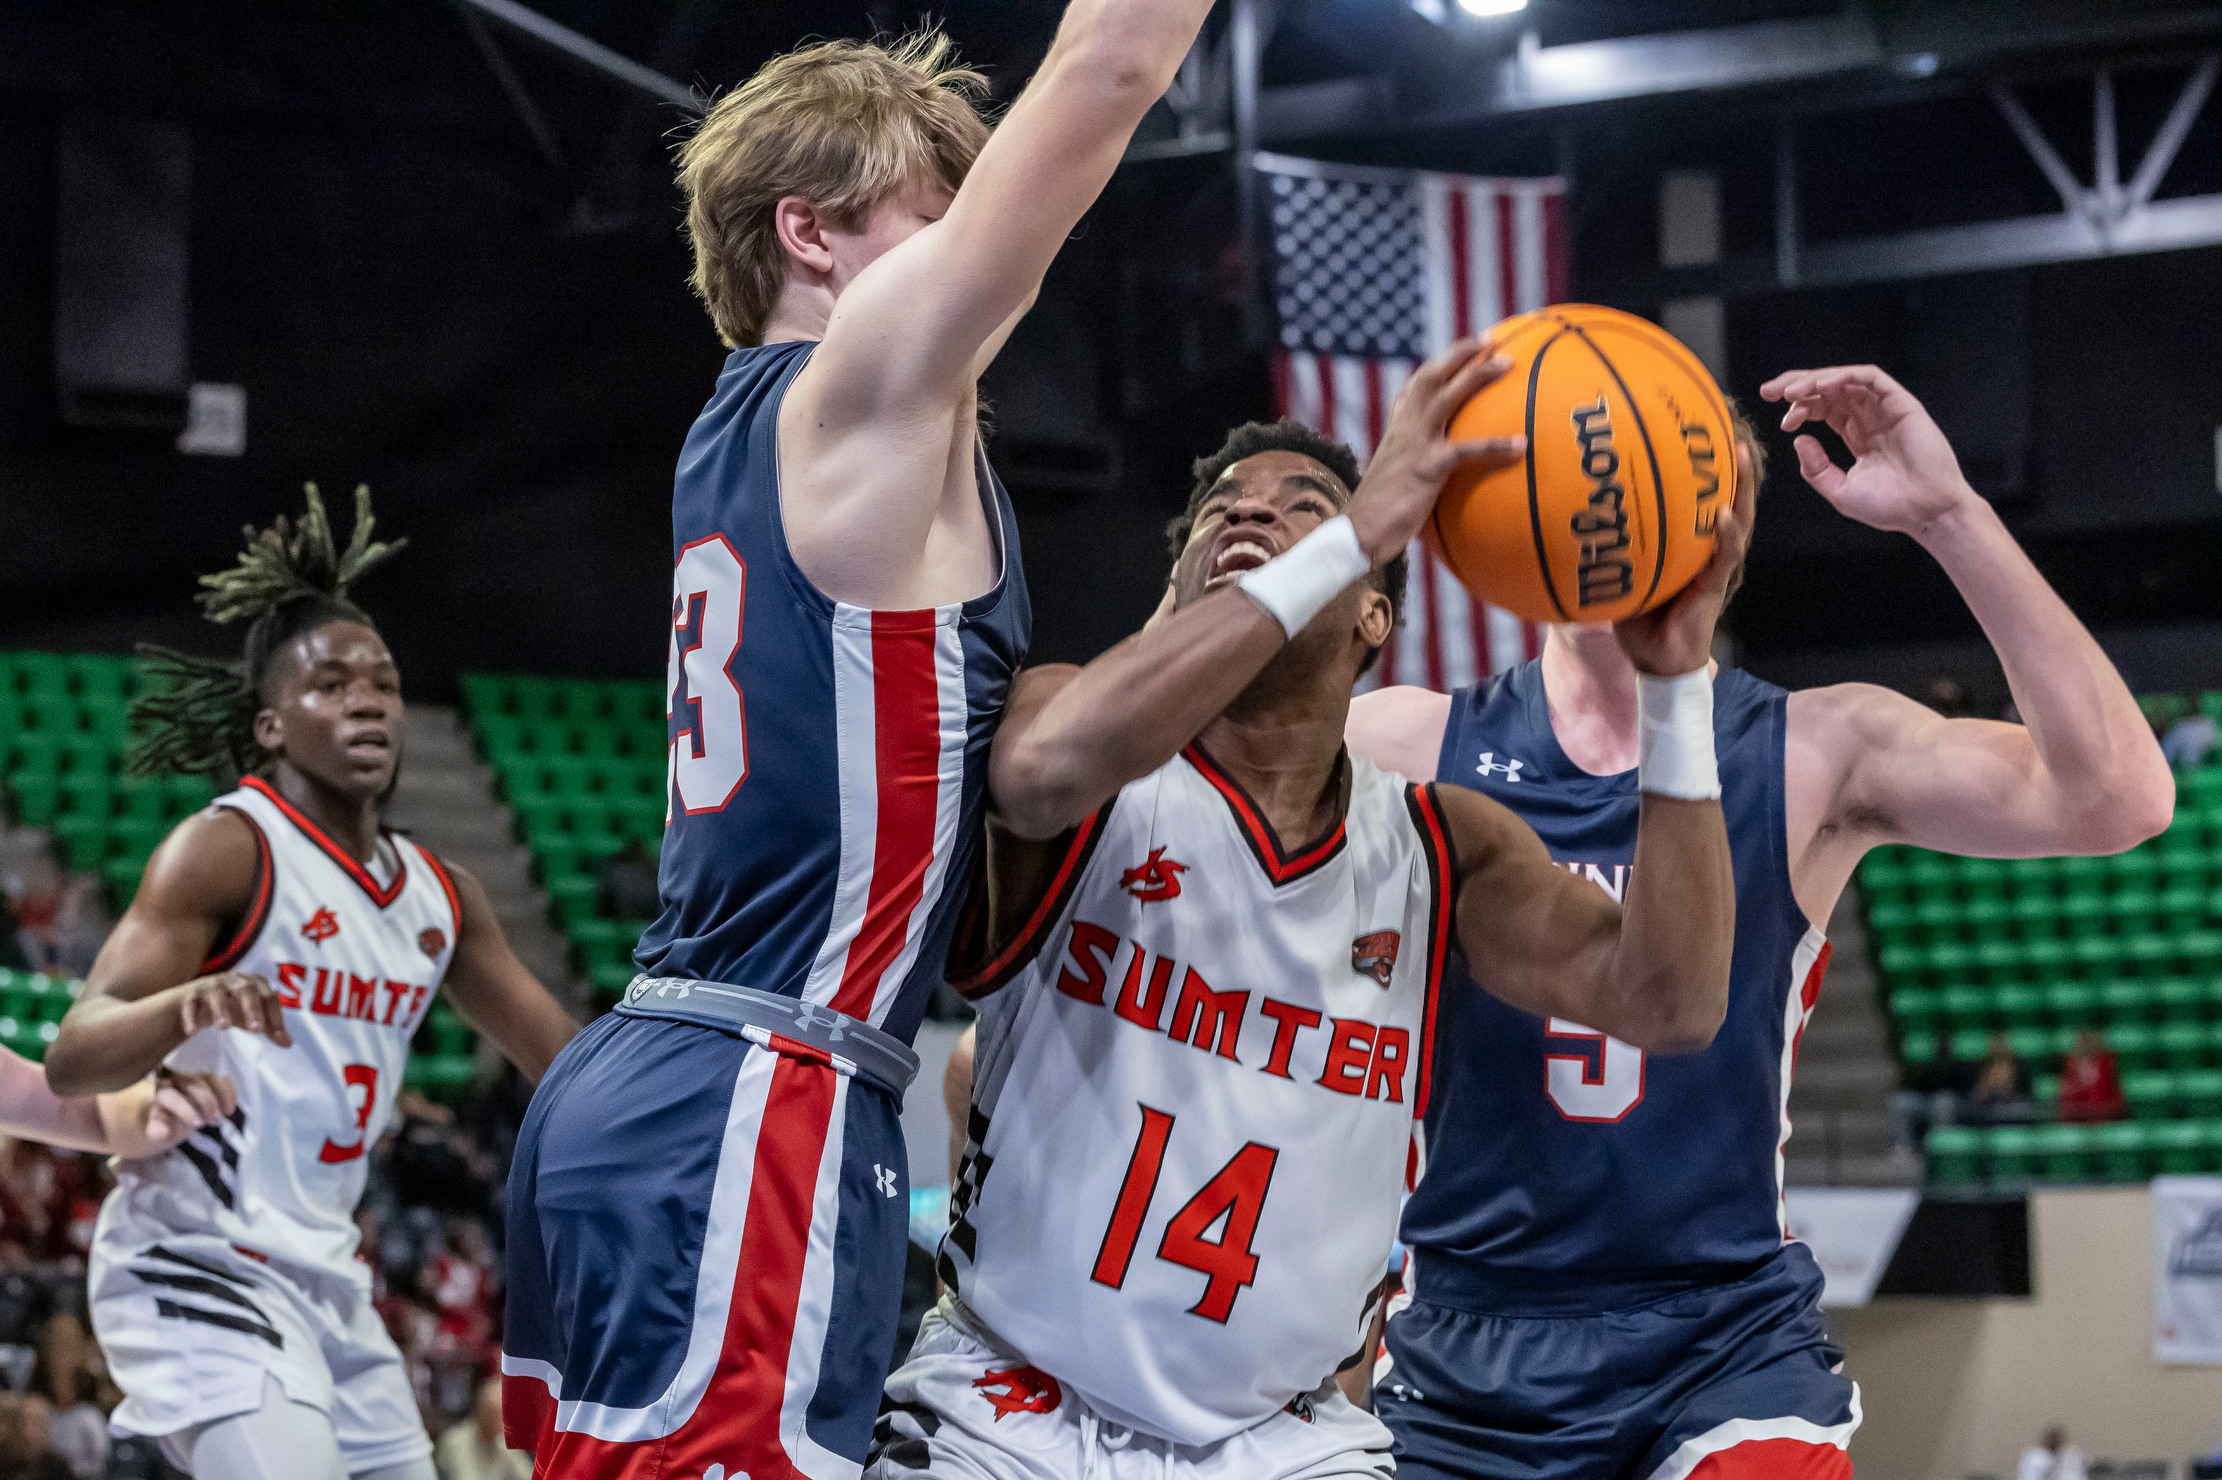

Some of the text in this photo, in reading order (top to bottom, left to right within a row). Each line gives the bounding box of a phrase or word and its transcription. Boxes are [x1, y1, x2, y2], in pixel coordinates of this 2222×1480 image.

[1569, 395, 1634, 610] Wilson
[666, 532, 747, 826] 3
[318, 1063, 378, 1165] 3
[1055, 919, 1410, 1104] SUMTER
[1089, 1099, 1280, 1326] 14
